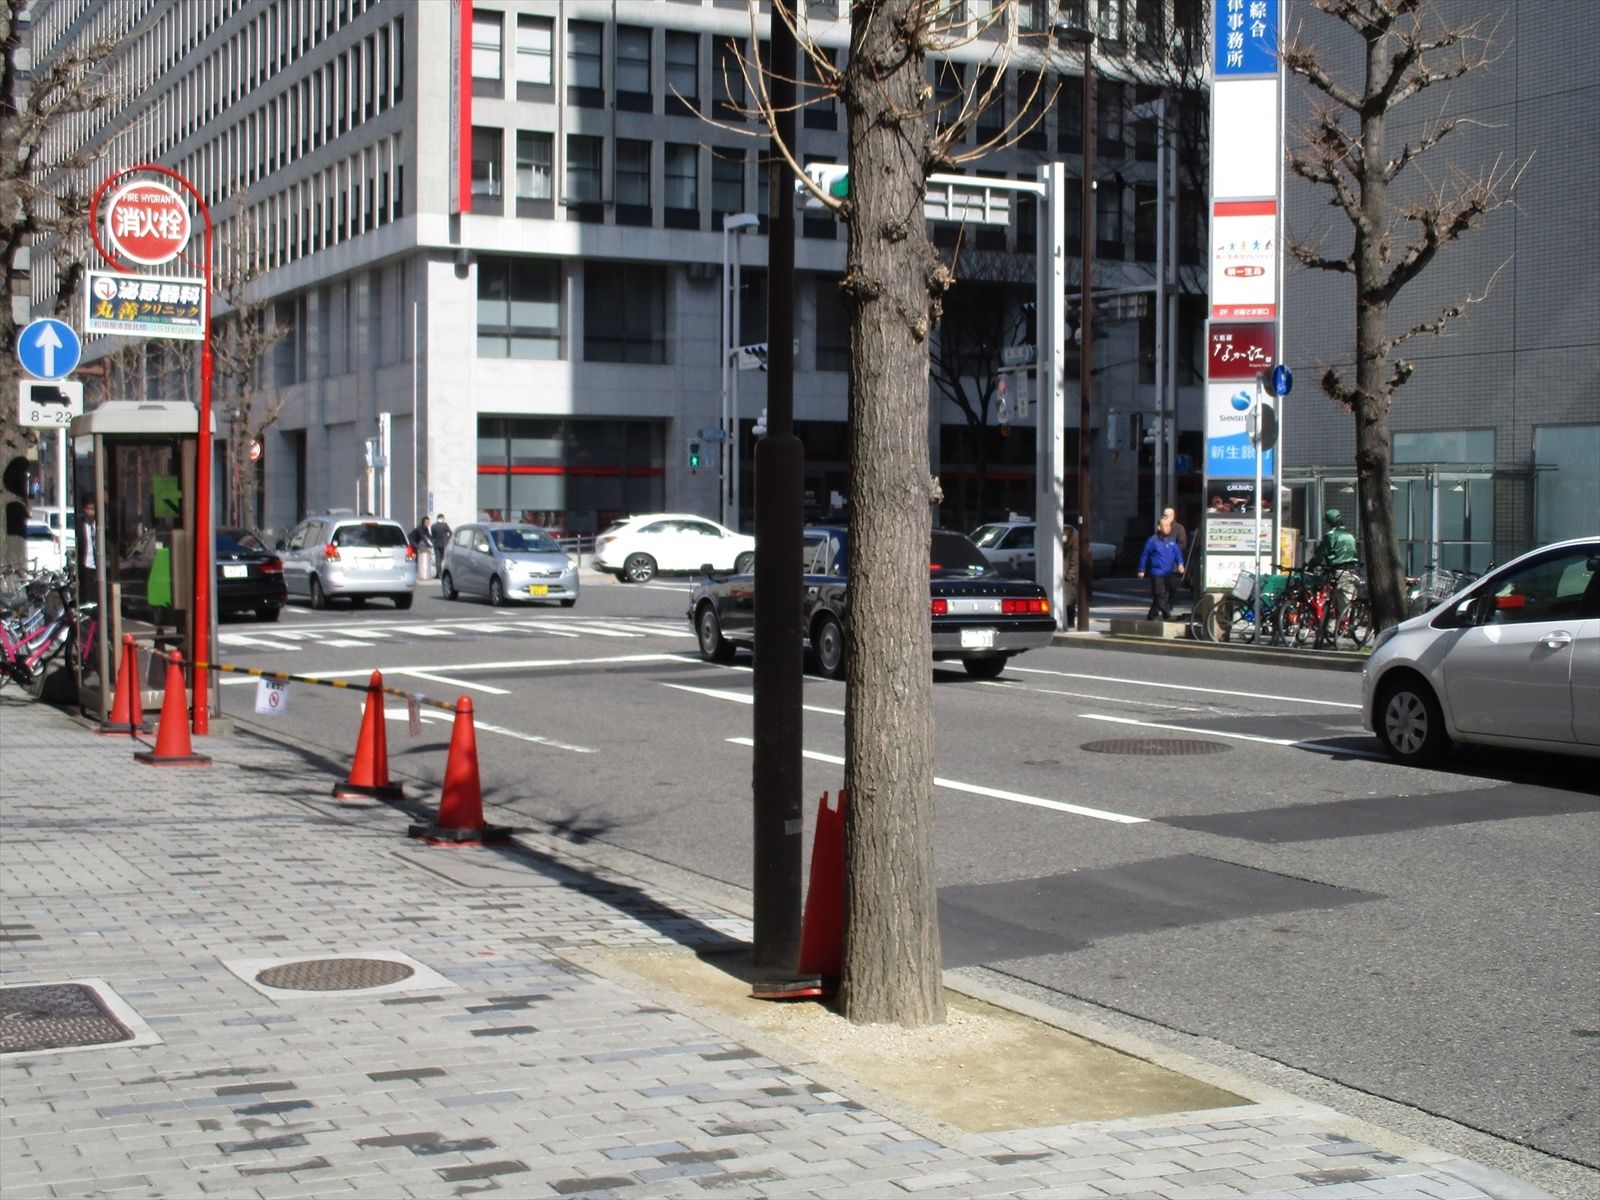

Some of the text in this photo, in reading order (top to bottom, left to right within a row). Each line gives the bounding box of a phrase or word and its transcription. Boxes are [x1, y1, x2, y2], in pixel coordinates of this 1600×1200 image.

[122, 192, 175, 205] FIRE HYDRANT
[116, 206, 183, 240] 消火栓
[117, 280, 201, 305] 泌尿器科
[1219, 414, 1243, 422] SHINSEI
